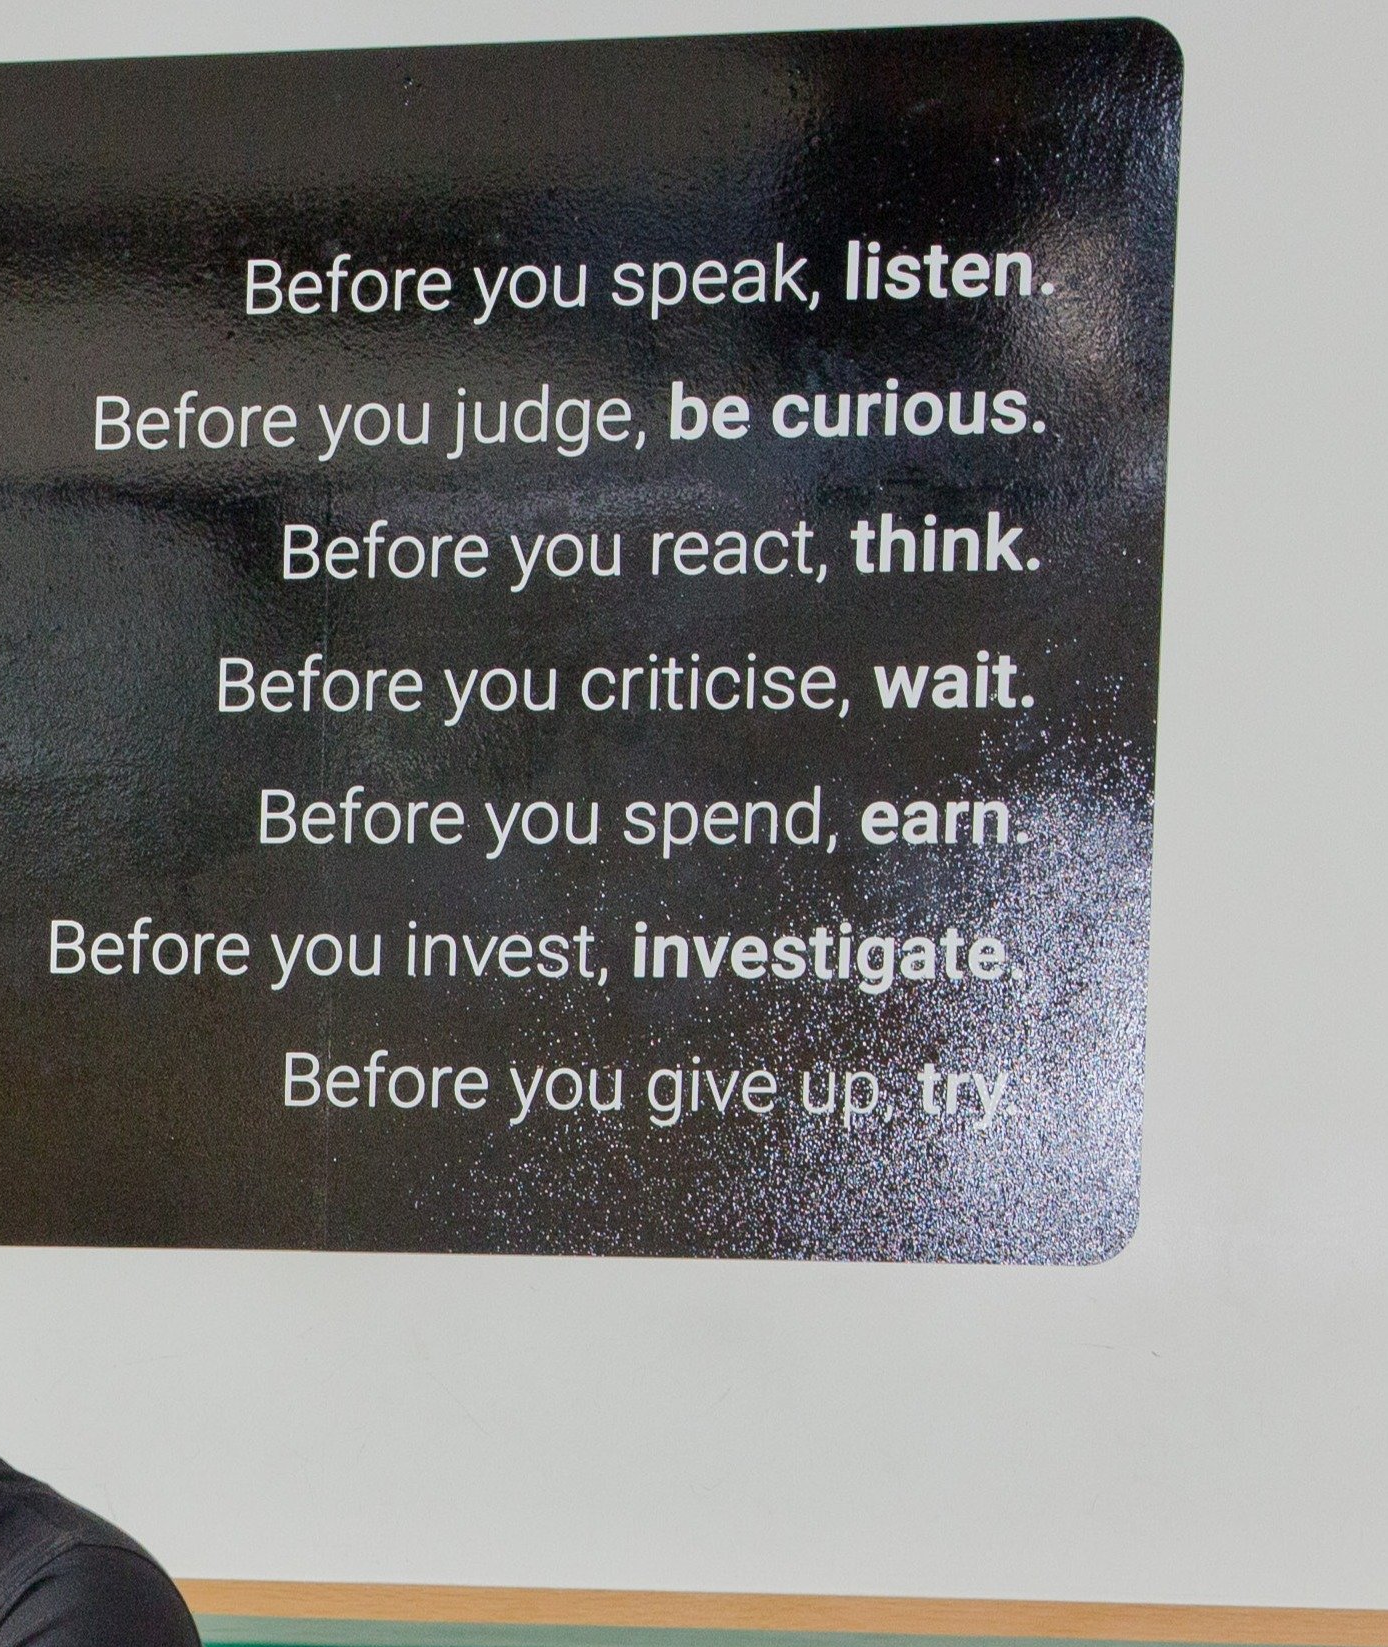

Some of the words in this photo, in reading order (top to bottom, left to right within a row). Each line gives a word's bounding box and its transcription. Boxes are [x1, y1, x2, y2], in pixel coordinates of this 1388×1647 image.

[247, 254, 451, 314] Before
[474, 265, 586, 324] you
[612, 243, 819, 320] speak,
[847, 241, 1055, 299] listen.
[95, 390, 296, 450] Before
[319, 403, 429, 461] you
[447, 384, 645, 459] judge,
[670, 381, 749, 440] be
[773, 378, 1045, 438] curious.
[284, 520, 488, 579] Before
[511, 534, 620, 592] you
[652, 521, 826, 583] react,
[851, 512, 1040, 573] think.
[219, 654, 422, 712] Before
[444, 669, 556, 726] you
[582, 653, 849, 718] criticise,
[874, 651, 1034, 708] wait.
[260, 786, 464, 844] Before
[485, 802, 598, 859] you
[624, 786, 836, 859] spend,
[861, 798, 1029, 846] earn.
[50, 917, 249, 975] Before
[271, 934, 381, 990] you
[408, 926, 607, 986] invest,
[633, 920, 1024, 994] investigate.
[285, 1050, 488, 1109] Before
[510, 1066, 622, 1126] you
[648, 1056, 777, 1128] give
[802, 1070, 894, 1127] up,
[917, 1062, 1018, 1128] try.
